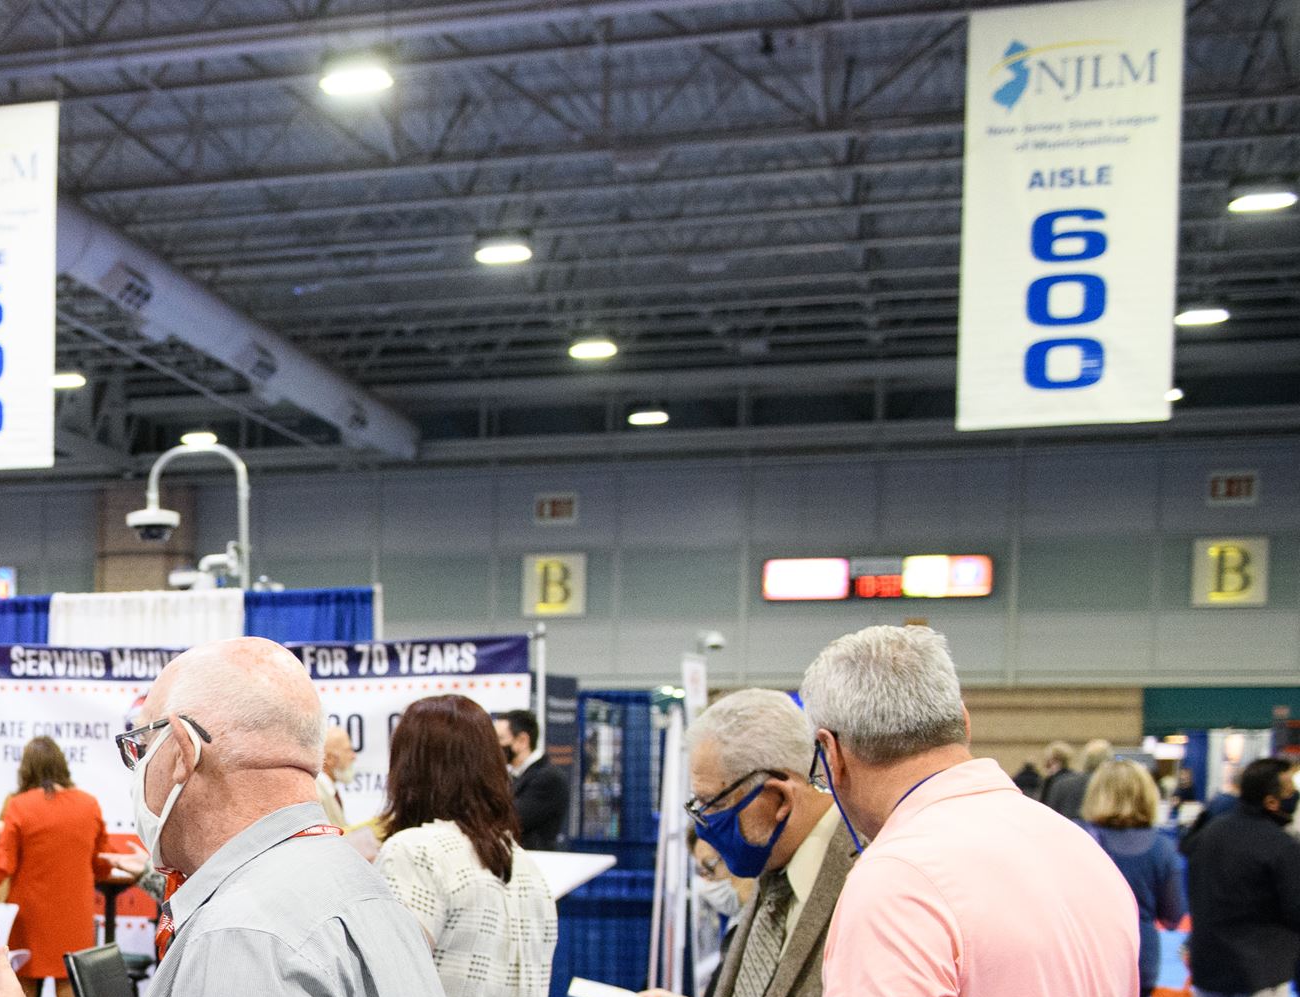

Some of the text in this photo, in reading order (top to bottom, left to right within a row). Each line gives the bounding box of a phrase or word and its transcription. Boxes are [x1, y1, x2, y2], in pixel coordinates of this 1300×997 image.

[1034, 48, 1161, 102] NJLM
[1026, 164, 1115, 192] AISLE
[535, 558, 572, 615] B
[1207, 545, 1251, 603] B
[9, 646, 106, 678] SERVING
[302, 646, 350, 677] FOR
[354, 643, 390, 675] 70
[395, 642, 478, 675] YEARS
[32, 720, 111, 740] CONTRACT
